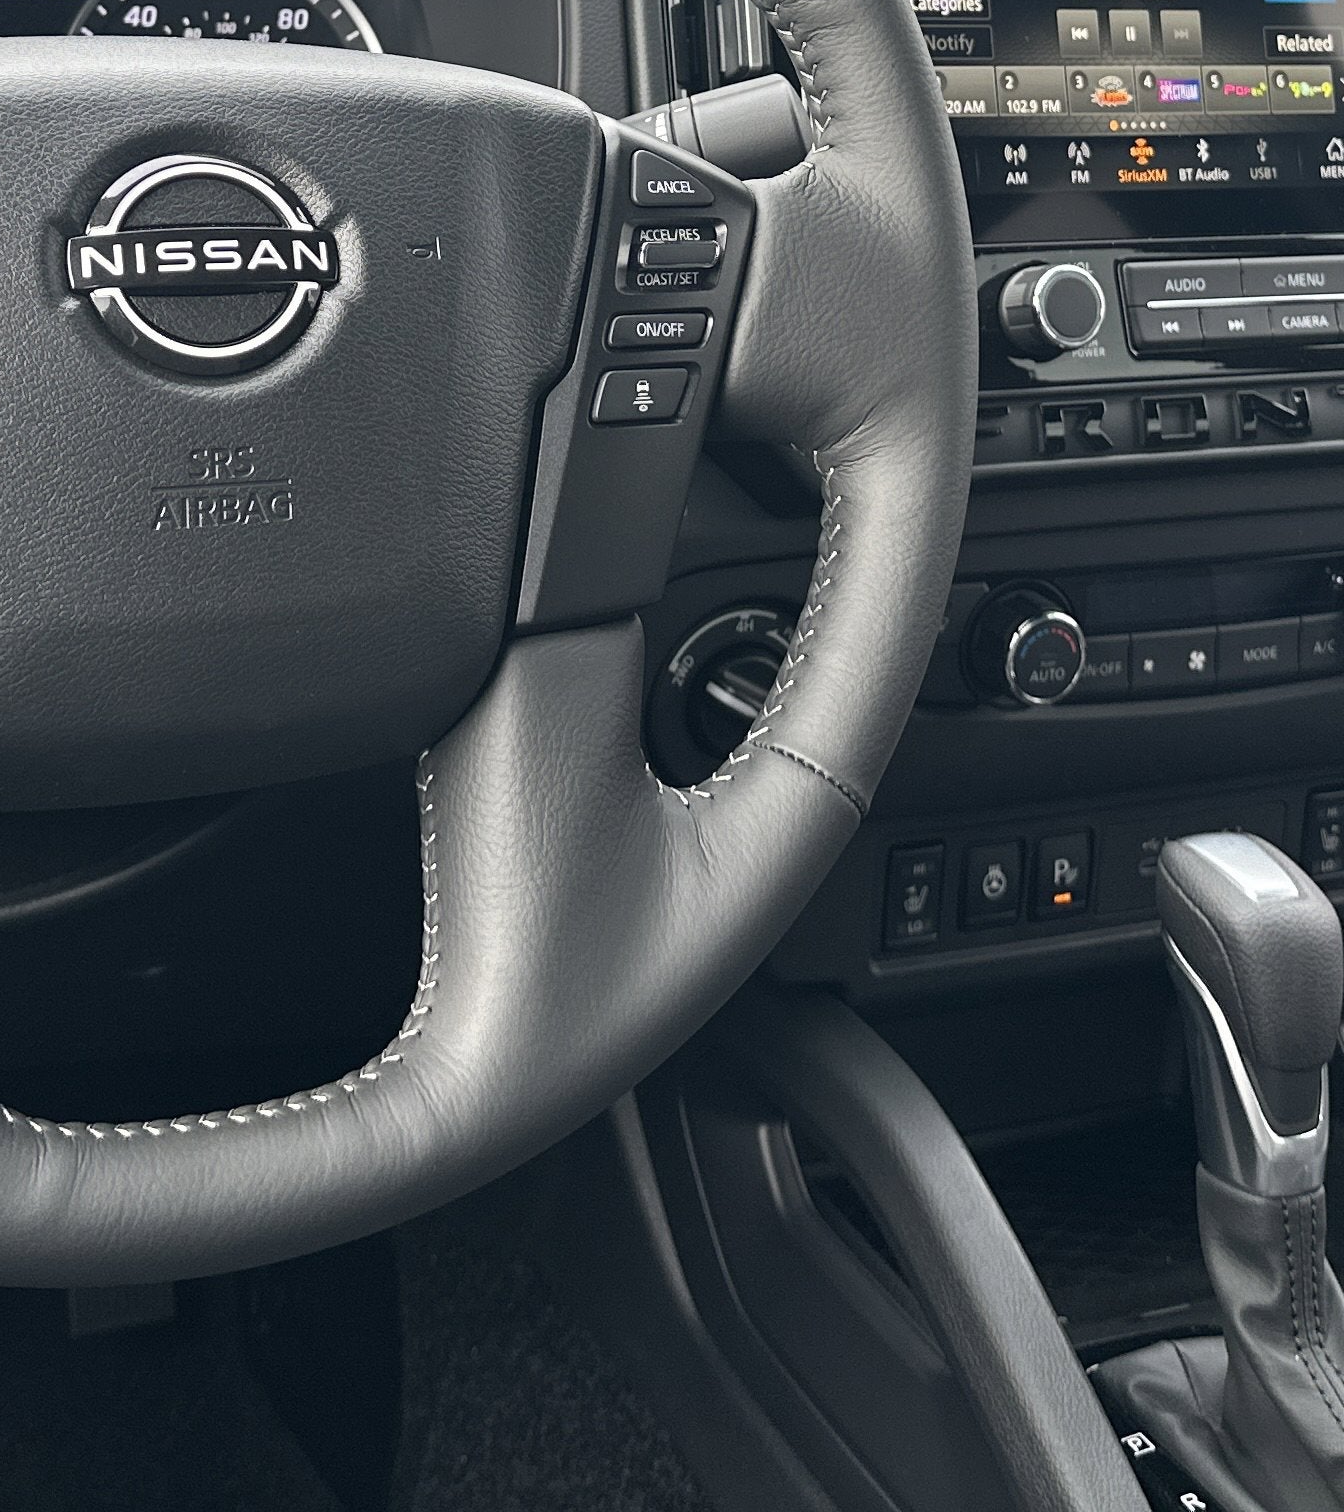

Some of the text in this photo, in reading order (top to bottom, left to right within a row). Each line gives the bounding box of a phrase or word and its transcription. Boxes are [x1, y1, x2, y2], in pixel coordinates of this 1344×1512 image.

[122, 5, 158, 28] 40
[277, 8, 309, 30] 80
[215, 21, 237, 35] 100
[925, 33, 975, 55] Notify
[1276, 34, 1334, 53] Related
[964, 100, 986, 114] AM
[1006, 100, 1061, 114] 102.9 FM
[1006, 171, 1028, 185] AM
[1071, 170, 1090, 184] FM
[1118, 168, 1167, 183] SiriusXM
[1179, 168, 1229, 182] BT Audio
[1250, 168, 1277, 180] USB1
[647, 180, 695, 194] CANCEL
[640, 228, 700, 242] ACCEL/RES
[80, 239, 329, 279] NISSAN
[637, 271, 699, 286] COAST/SET
[1165, 277, 1206, 293] AUDIO
[1288, 273, 1325, 287] MENU
[636, 322, 685, 338] ON/OFF
[1282, 315, 1329, 330] CAMERA
[1072, 347, 1105, 358] POWER
[189, 445, 255, 480] SRS
[155, 491, 294, 531] AIRBAG
[736, 619, 754, 632] 4H
[1243, 645, 1278, 661] MODE
[1313, 640, 1335, 655] A/C
[1029, 667, 1066, 683] AUTO
[1179, 1492, 1207, 1512] R
